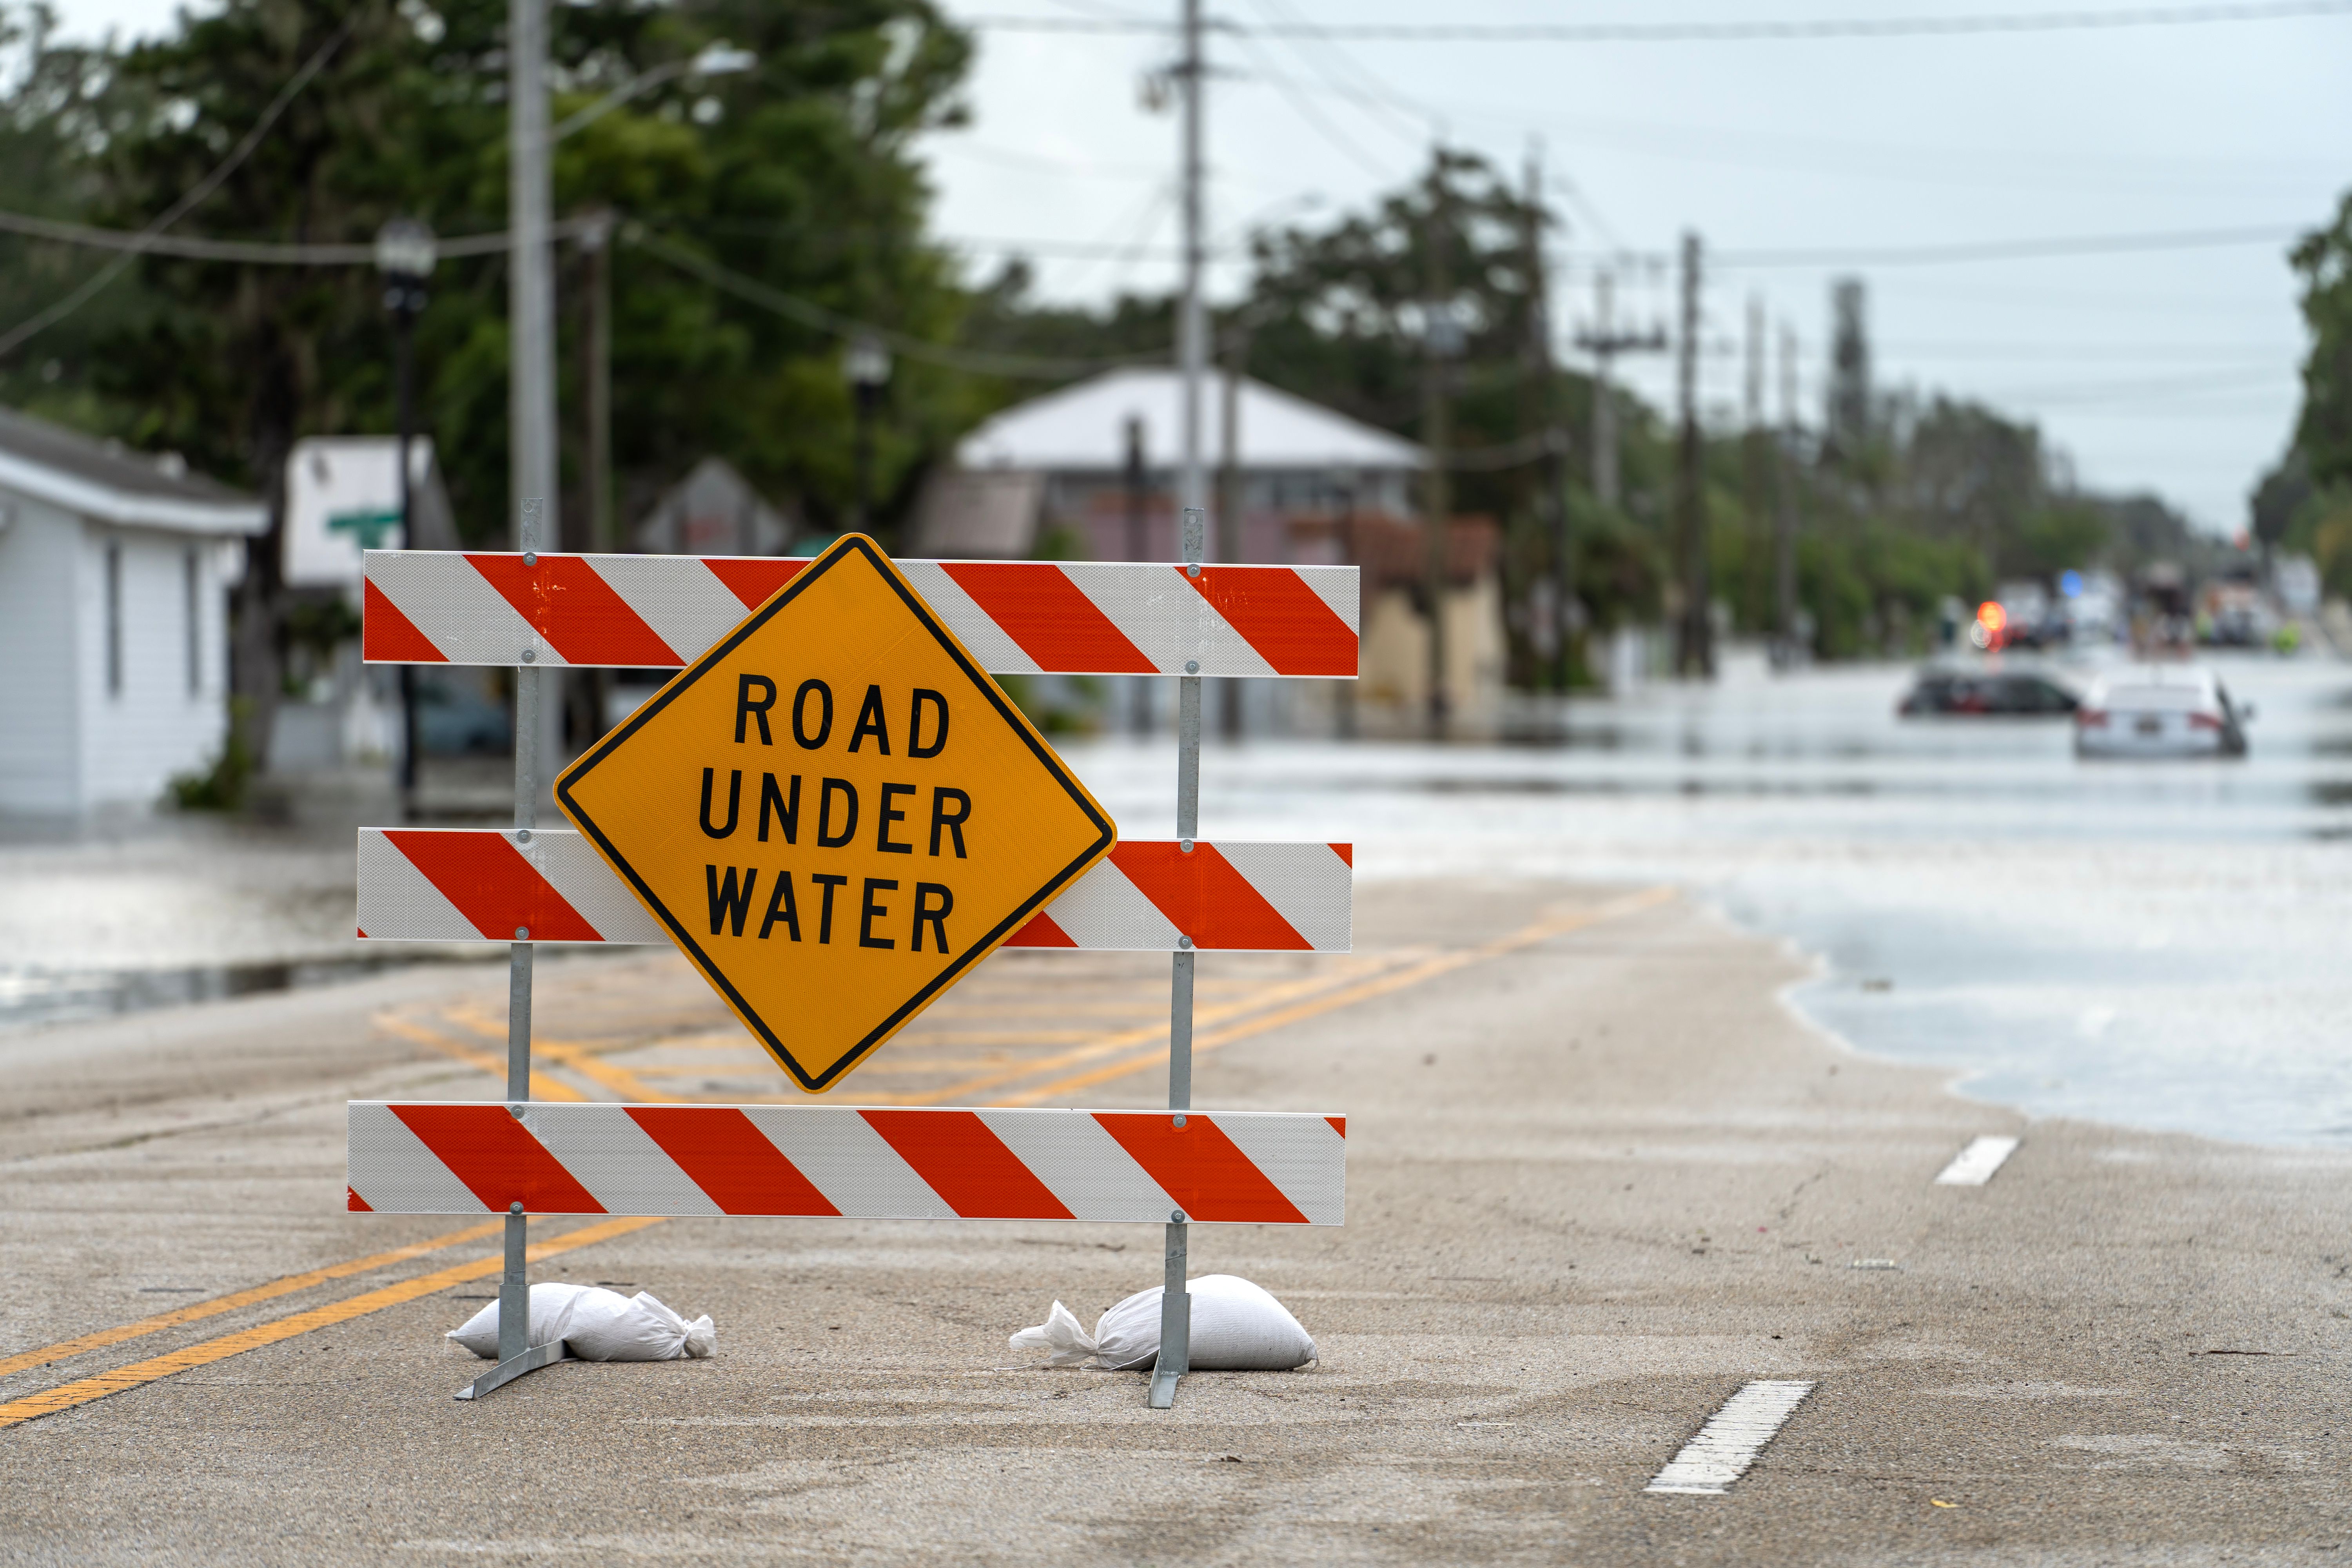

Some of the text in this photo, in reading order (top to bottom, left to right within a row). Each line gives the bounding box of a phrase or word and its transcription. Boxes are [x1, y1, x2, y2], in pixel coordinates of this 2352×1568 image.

[734, 673, 949, 759] ROAD
[699, 767, 971, 859] UNDER
[706, 864, 953, 954] WATER
